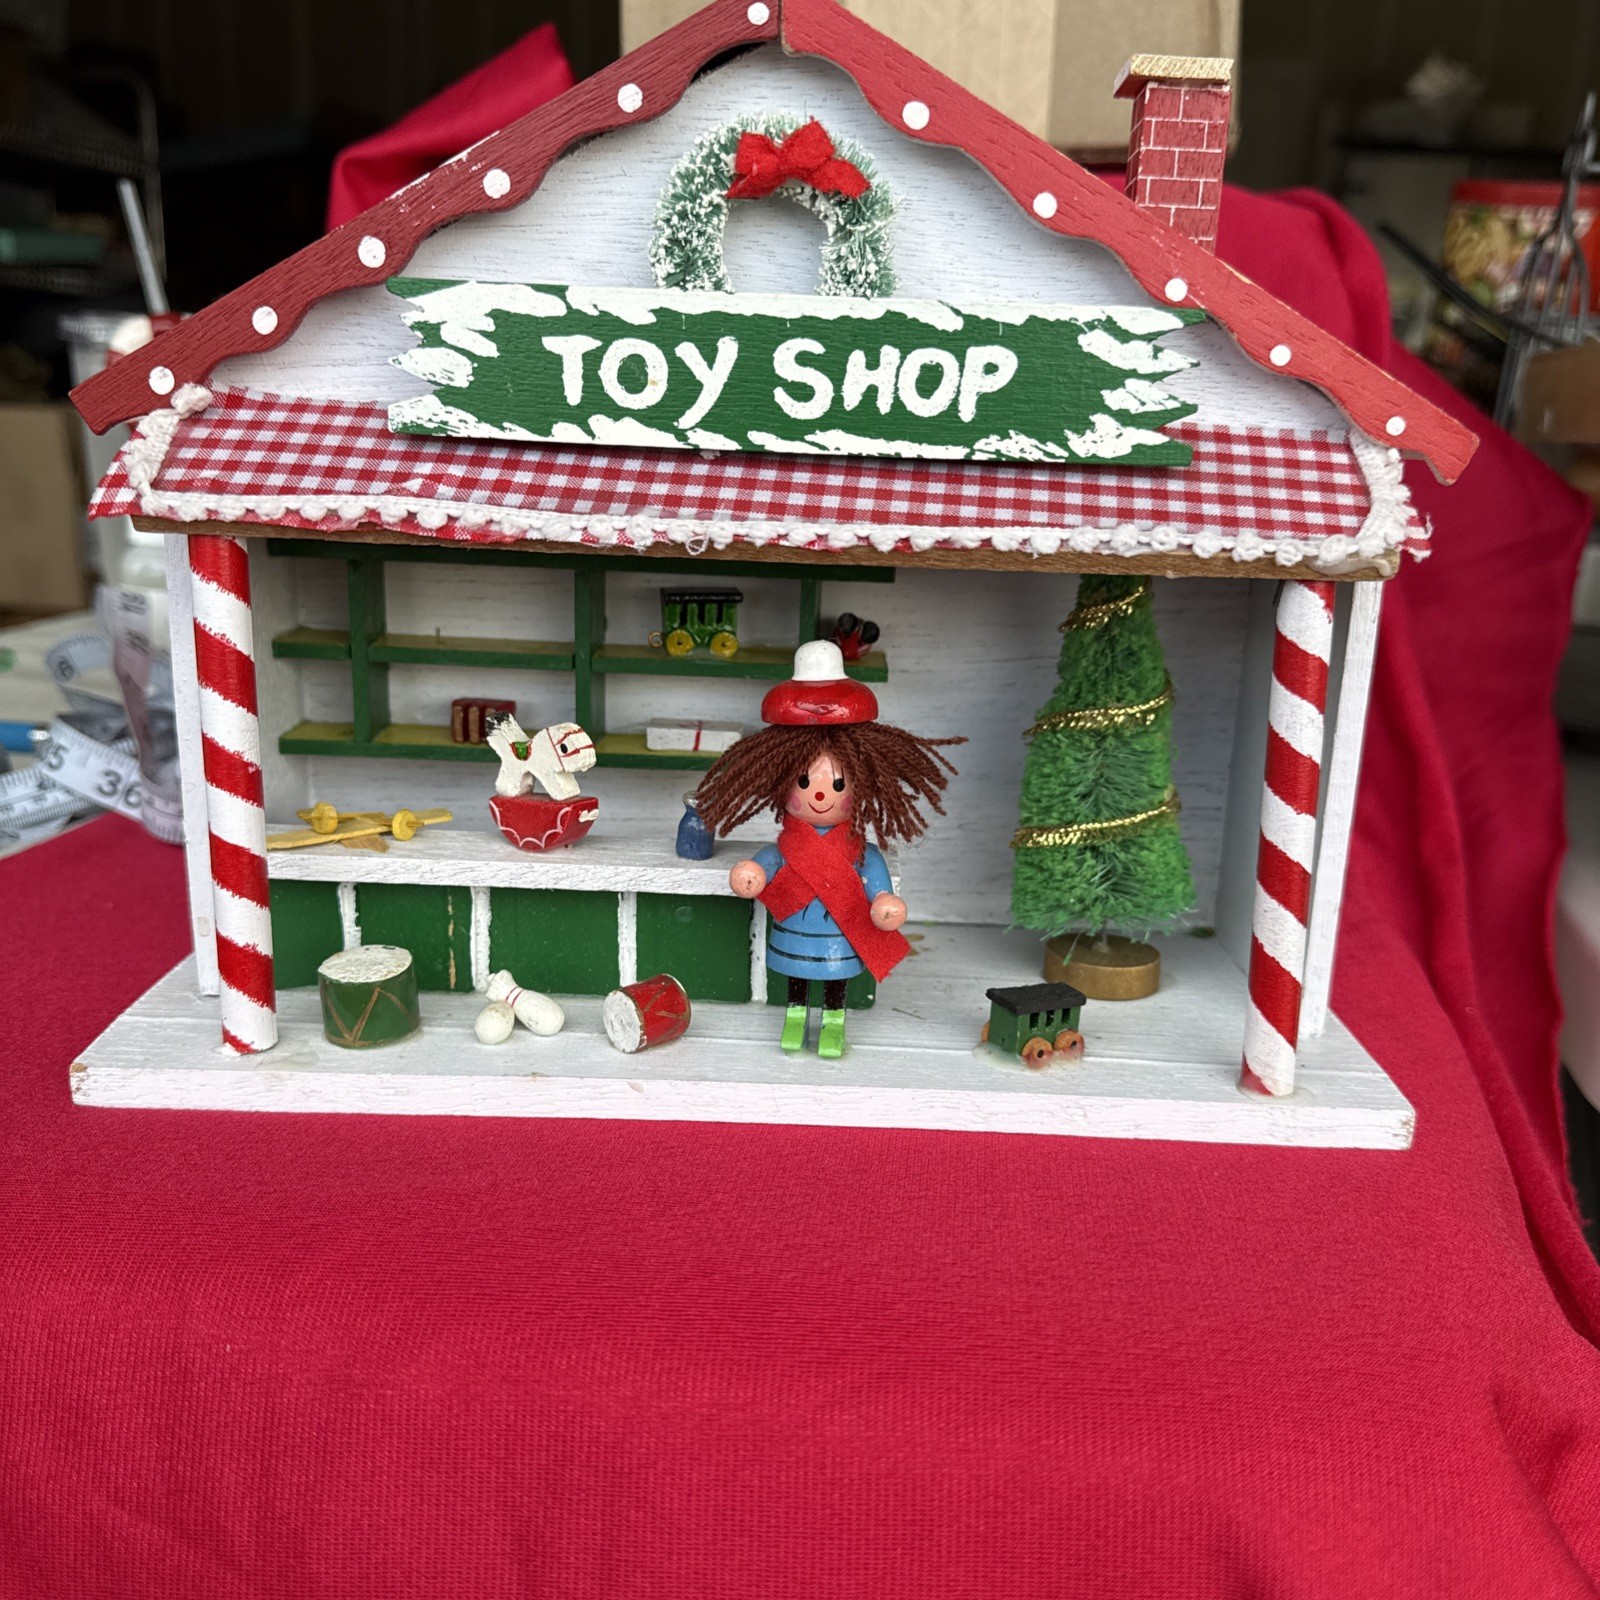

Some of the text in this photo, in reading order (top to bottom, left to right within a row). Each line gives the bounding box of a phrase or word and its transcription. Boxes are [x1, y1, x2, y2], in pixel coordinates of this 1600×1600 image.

[541, 335, 1019, 430] TOY SHOP
[98, 770, 143, 808] 36
